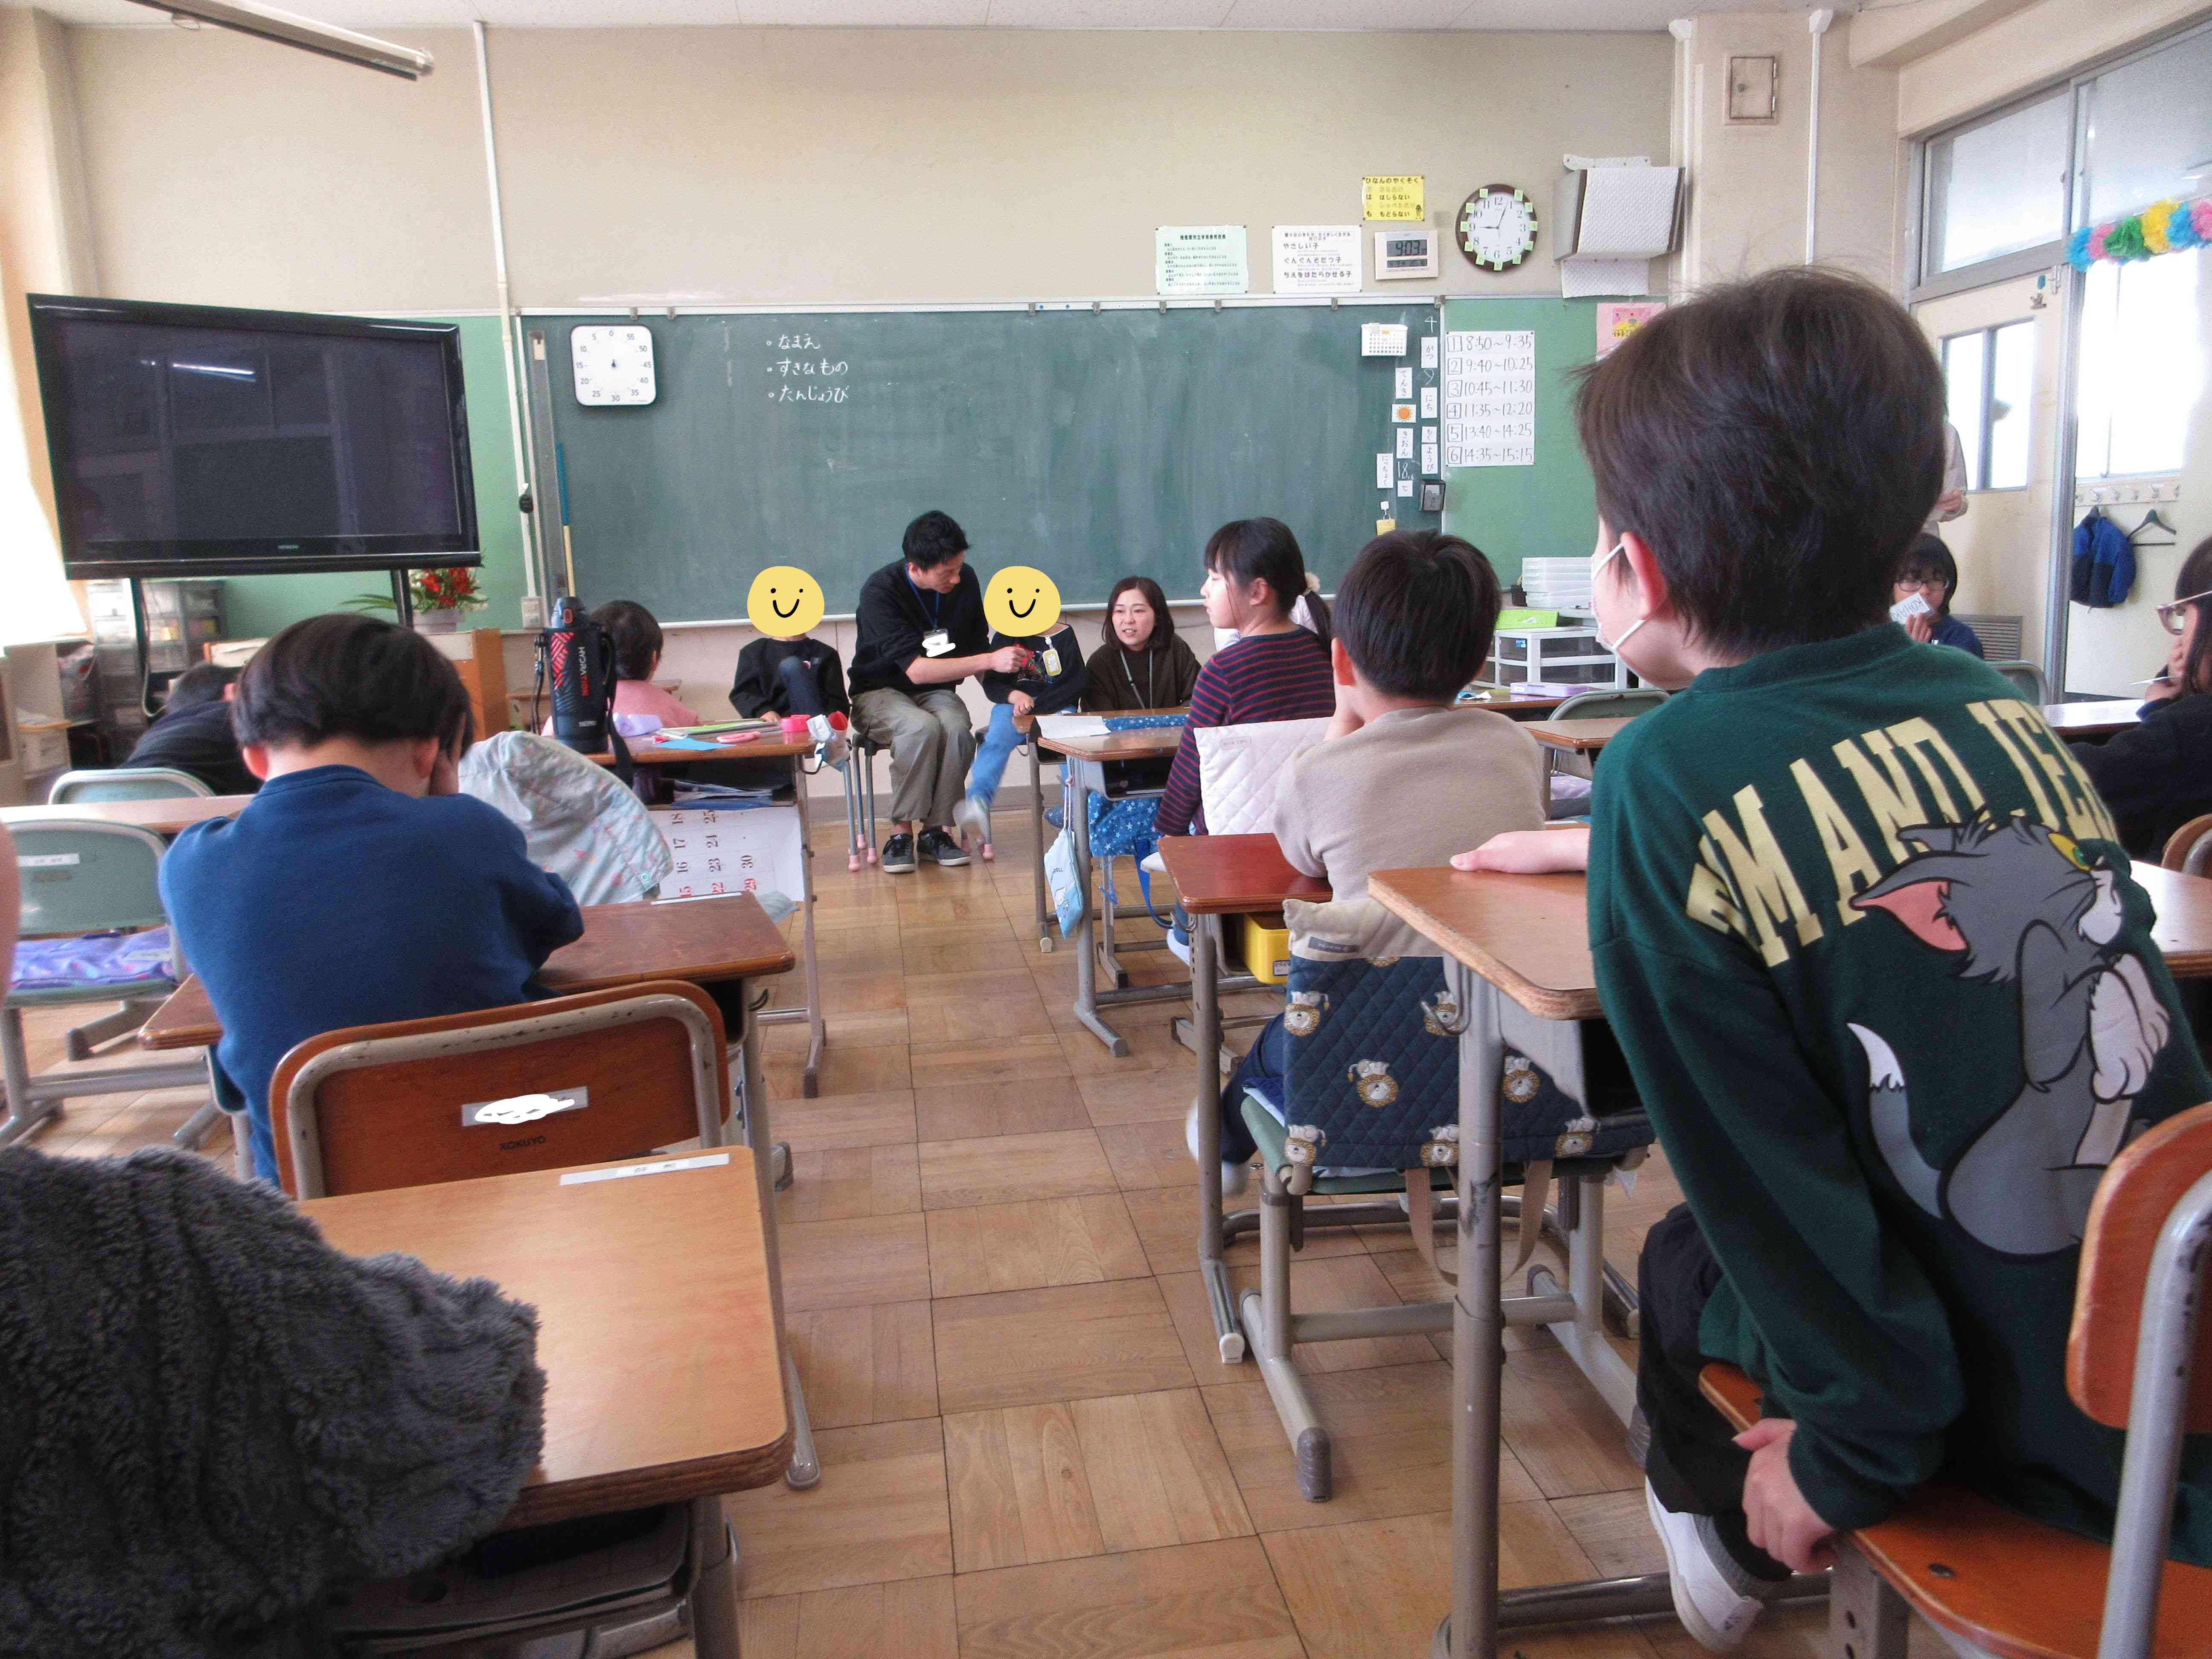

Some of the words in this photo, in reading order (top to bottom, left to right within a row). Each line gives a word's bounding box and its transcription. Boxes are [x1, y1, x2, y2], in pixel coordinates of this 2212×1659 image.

[1483, 201, 1490, 209] 11
[1494, 197, 1503, 205] 12
[1473, 210, 1482, 218] 10
[1517, 210, 1522, 218] 2
[1469, 224, 1476, 232] 9
[1520, 224, 1526, 232] 3
[1473, 237, 1479, 245] 8
[1516, 237, 1521, 246] 4
[1483, 247, 1488, 255] 7
[1494, 250, 1500, 259] 6
[1506, 247, 1512, 255] 5
[1424, 315, 1437, 333] 4
[778, 334, 820, 349] なまえ
[1426, 345, 1434, 359] がつ
[779, 384, 849, 403] たんじょうび
[1426, 395, 1433, 411] にち
[671, 812, 683, 824] 18
[703, 810, 716, 824] 25
[1789, 717, 1998, 926] AND
[673, 838, 686, 850] 17
[676, 861, 689, 874] 16
[708, 858, 721, 872] 23
[741, 855, 754, 869] 30
[744, 878, 757, 891] 29
